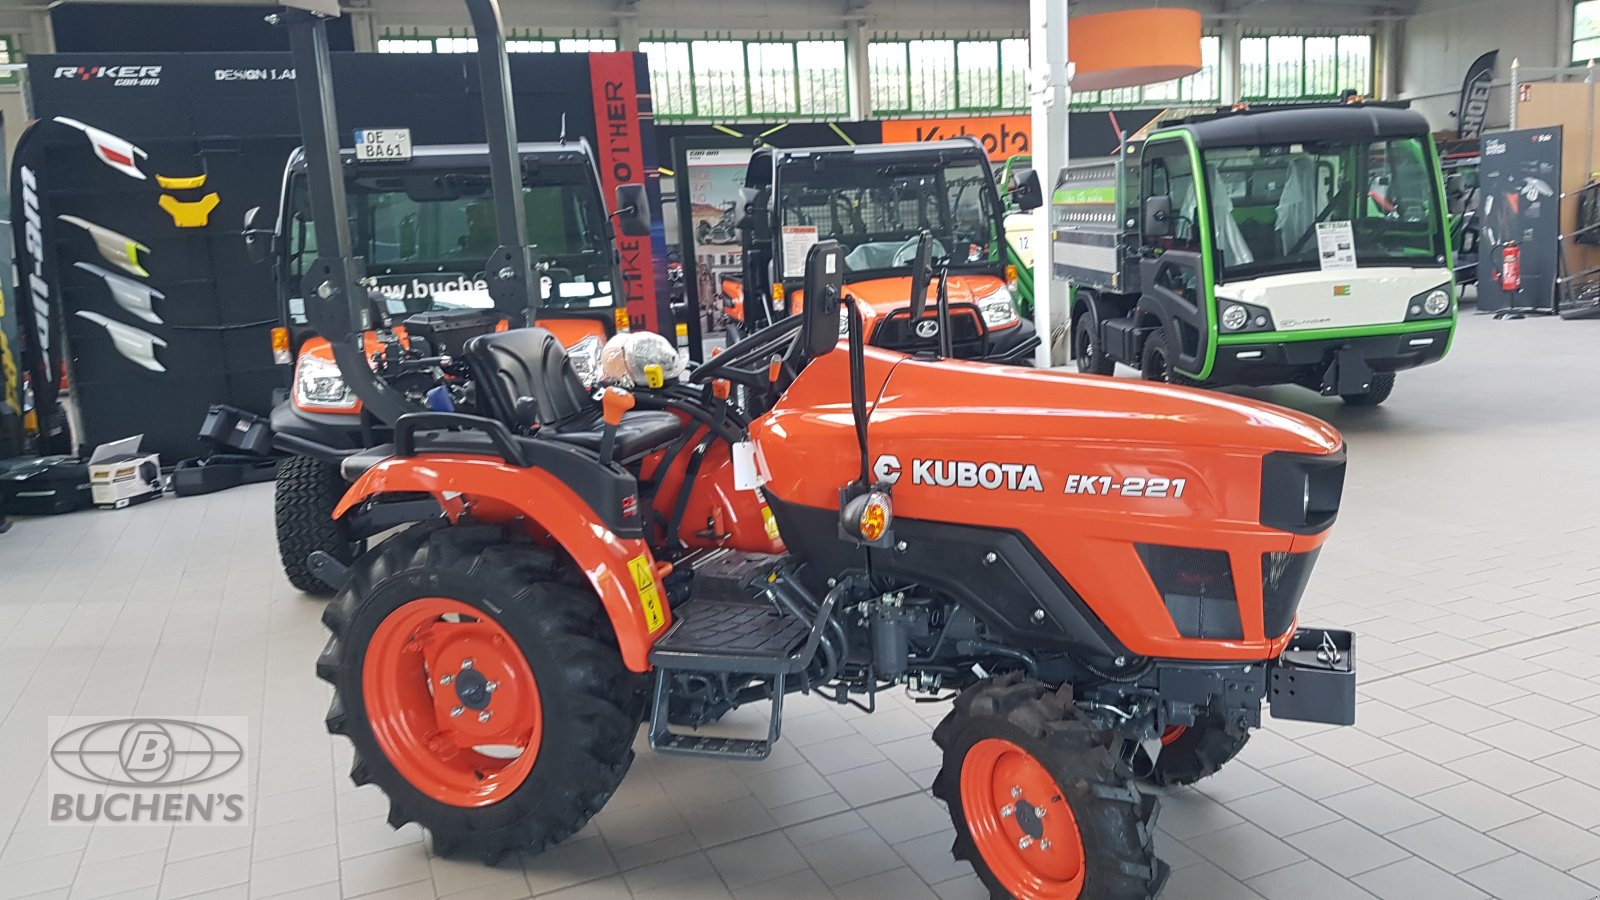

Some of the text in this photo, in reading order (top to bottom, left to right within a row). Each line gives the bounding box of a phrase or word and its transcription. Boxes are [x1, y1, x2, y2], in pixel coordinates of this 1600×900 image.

[214, 68, 297, 81] DESIGN LA
[605, 80, 633, 183] OTHER
[911, 458, 1044, 492] KUBOTA
[1063, 473, 1187, 499] EK1-221
